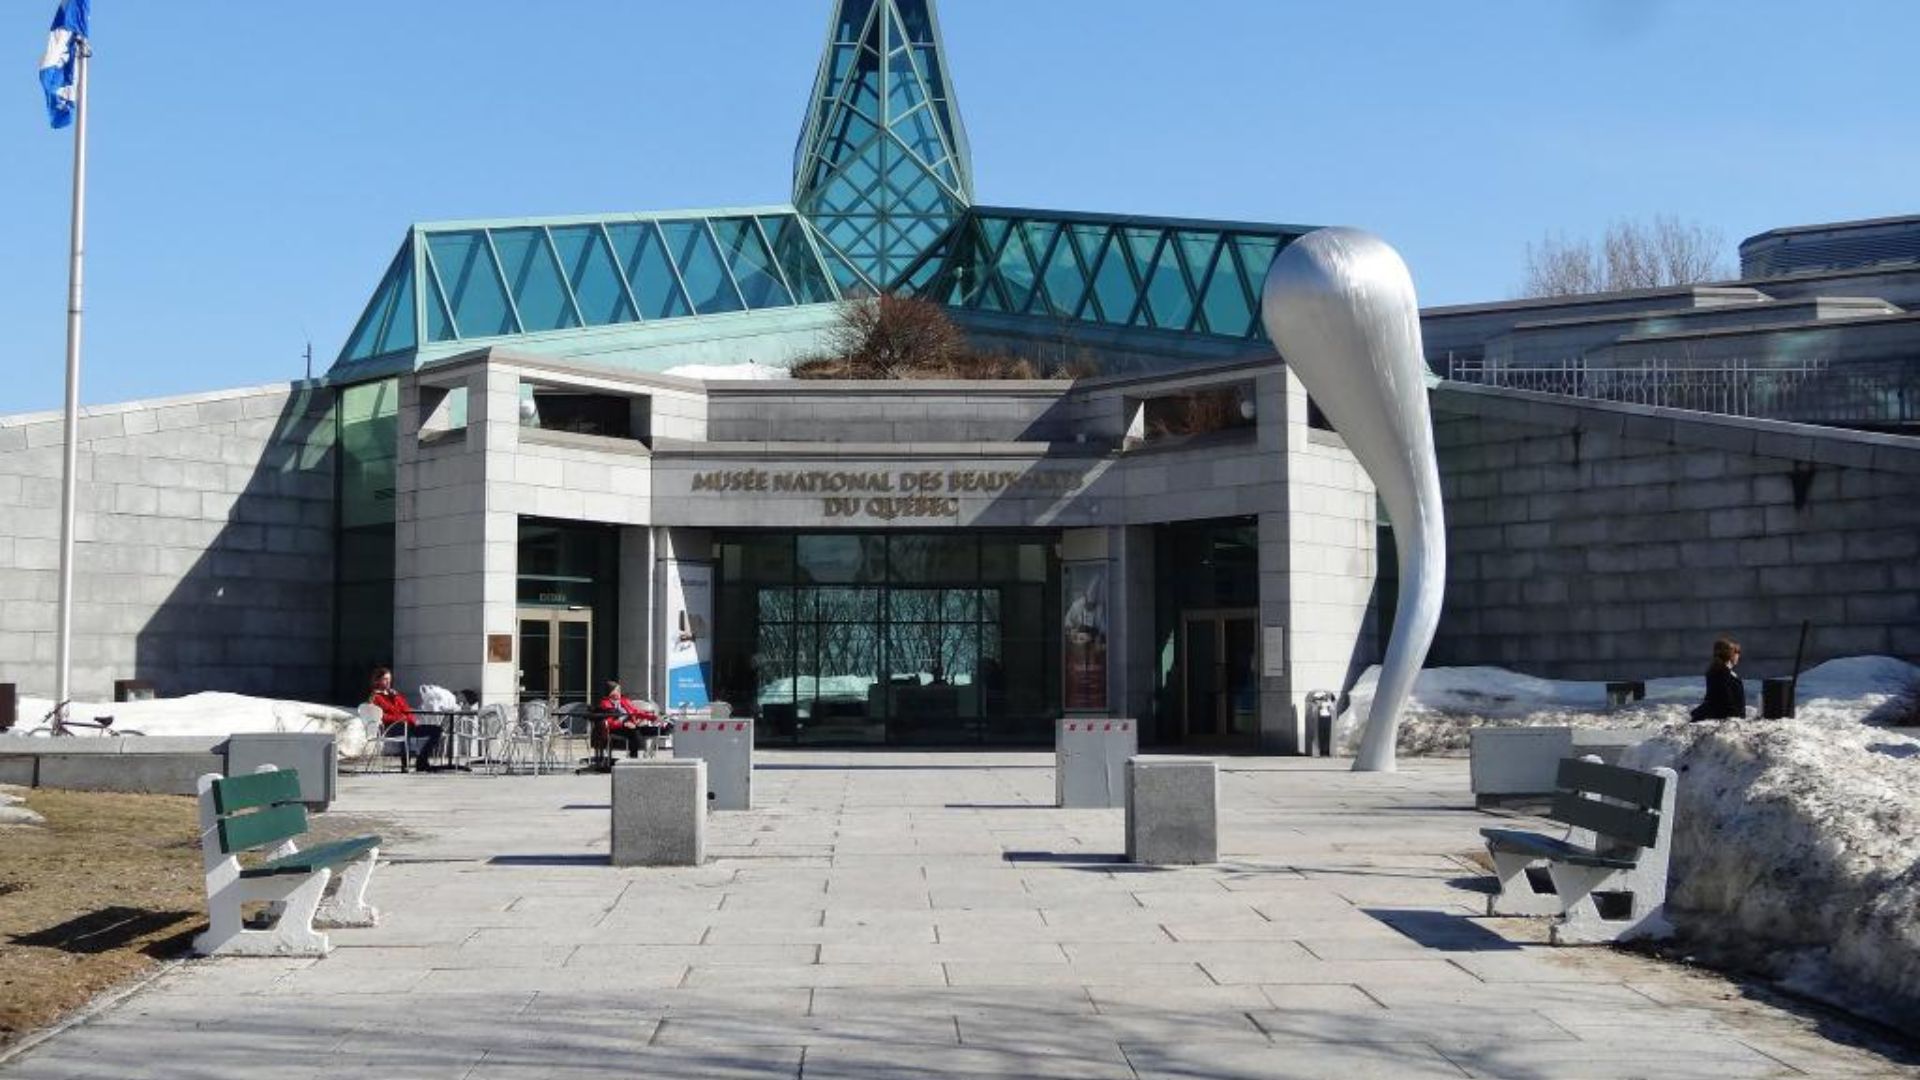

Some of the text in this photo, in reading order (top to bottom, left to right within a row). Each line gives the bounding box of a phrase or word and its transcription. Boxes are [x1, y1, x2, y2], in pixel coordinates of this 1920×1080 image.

[691, 469, 768, 491] MUSÉE
[772, 471, 895, 492] NATIONAL
[899, 471, 943, 492] DES
[823, 496, 861, 517] DU
